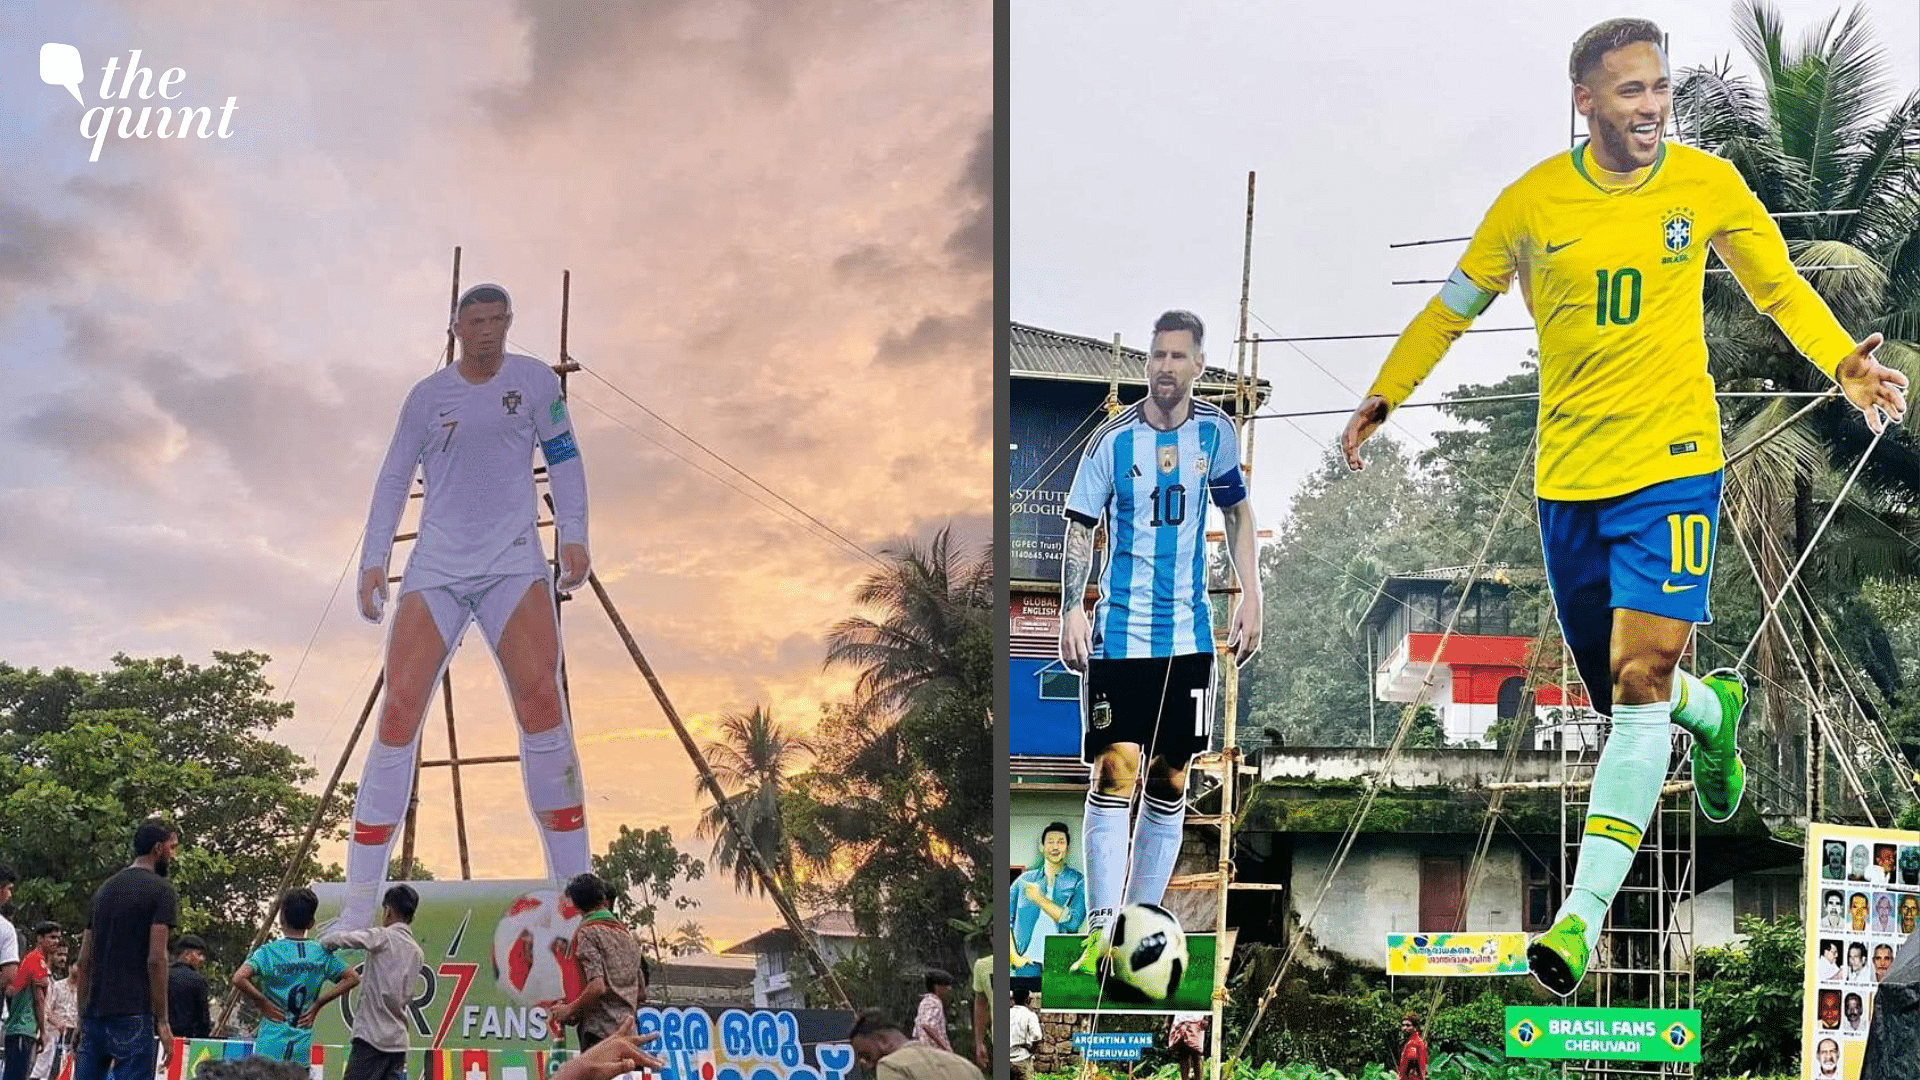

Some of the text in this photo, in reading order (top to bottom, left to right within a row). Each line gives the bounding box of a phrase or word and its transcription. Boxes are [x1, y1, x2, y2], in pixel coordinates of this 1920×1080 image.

[1596, 267, 1642, 326] 10
[442, 421, 459, 453] 7
[1150, 484, 1186, 527] 10
[1667, 513, 1711, 576] 10
[1022, 606, 1056, 616] ENGLISH
[1023, 597, 1058, 607] GLOBAL
[462, 1004, 549, 1041] FANS
[1548, 1019, 1657, 1037] BRASIL FANS
[718, 1009, 802, 1068] ഒരു
[1075, 1036, 1153, 1044] ARGENTINA FANS
[1564, 1039, 1641, 1053] CHERUVADI
[1087, 1048, 1139, 1057] CHERUVADI
